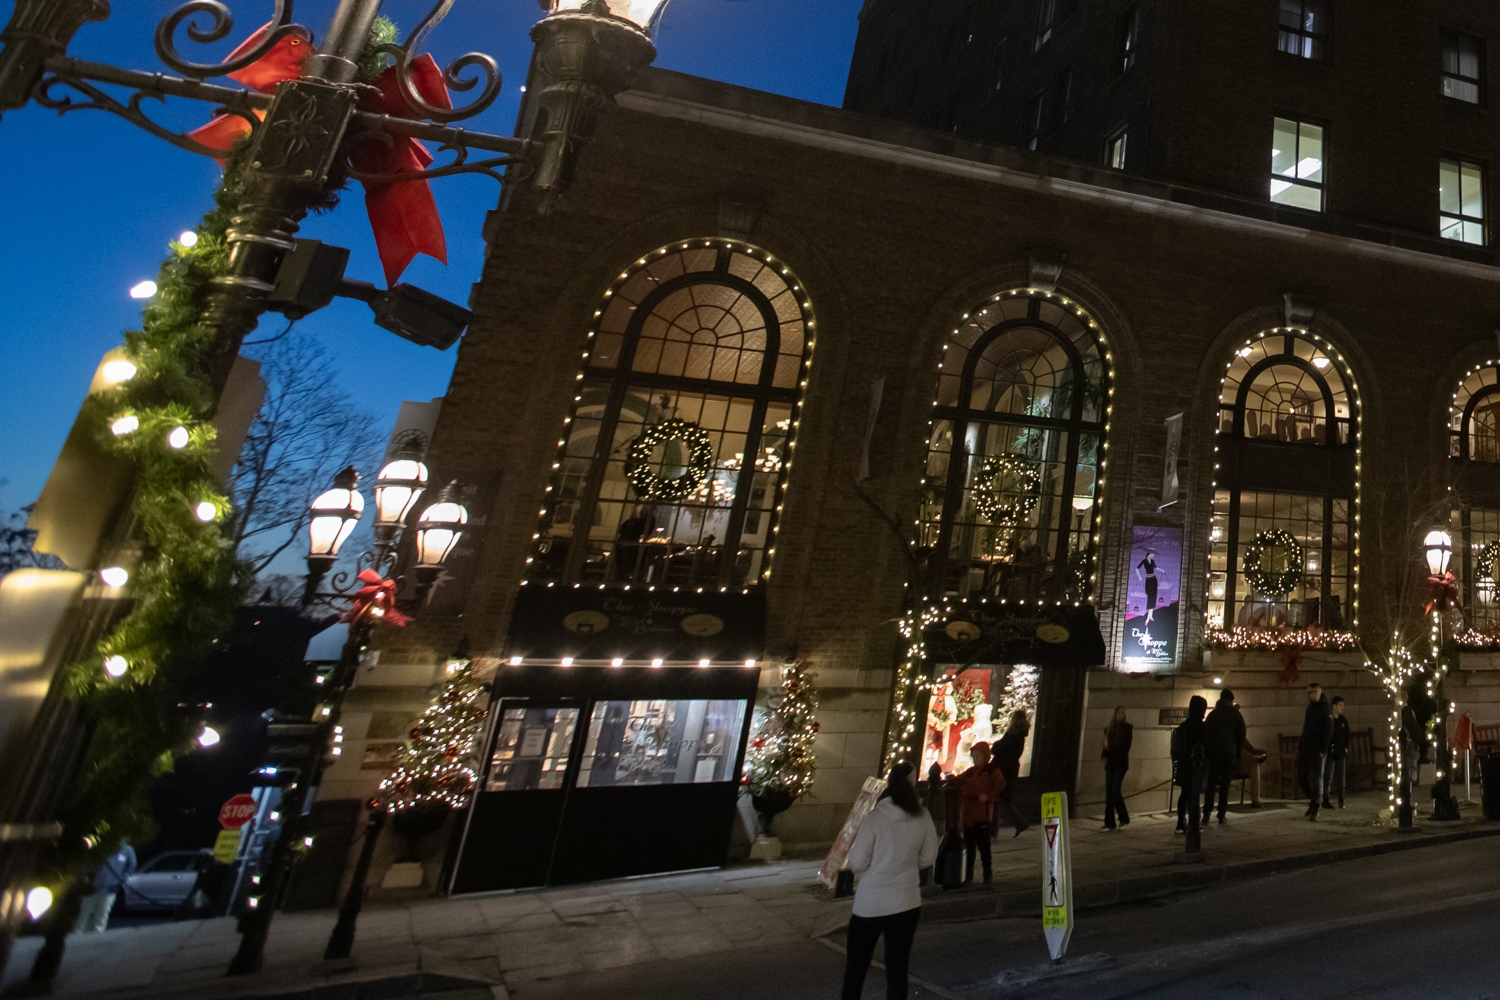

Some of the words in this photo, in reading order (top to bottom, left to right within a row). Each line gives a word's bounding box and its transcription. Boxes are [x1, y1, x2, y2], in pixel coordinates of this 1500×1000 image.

[602, 598, 634, 612] The
[645, 600, 698, 616] Shoppe
[222, 804, 255, 819] STOP
